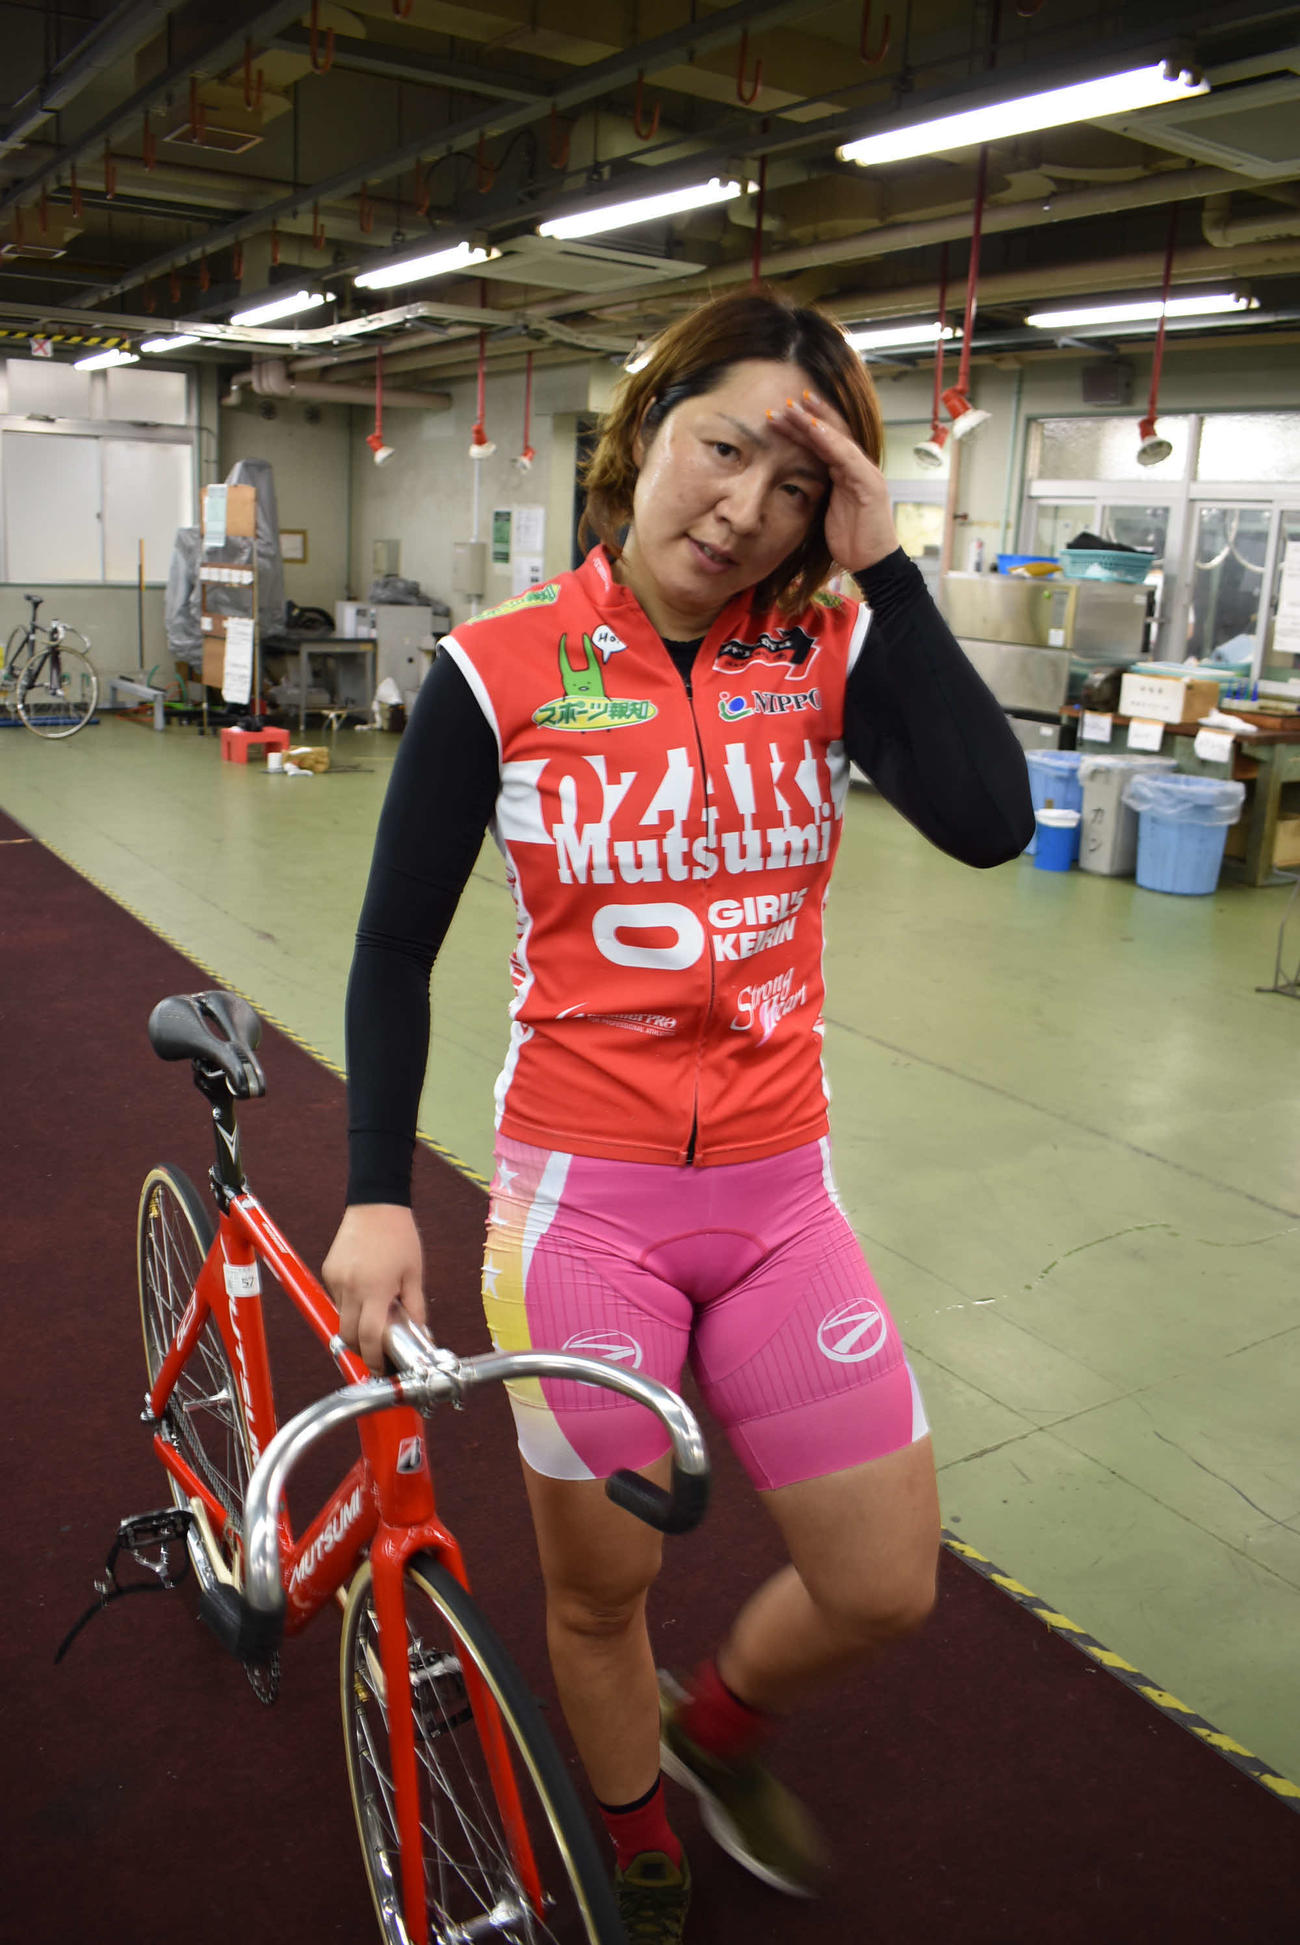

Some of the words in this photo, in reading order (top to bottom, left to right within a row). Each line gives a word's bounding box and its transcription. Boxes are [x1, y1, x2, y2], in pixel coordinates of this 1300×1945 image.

[536, 700, 651, 726] スポーツ報知
[537, 739, 837, 844] OZAKI
[552, 802, 831, 884] Mutsumi
[712, 917, 798, 962] KEIRIN
[730, 968, 795, 1031] Strong
[241, 1276, 254, 1289] 57
[288, 1485, 362, 1593] MUTSUMI
